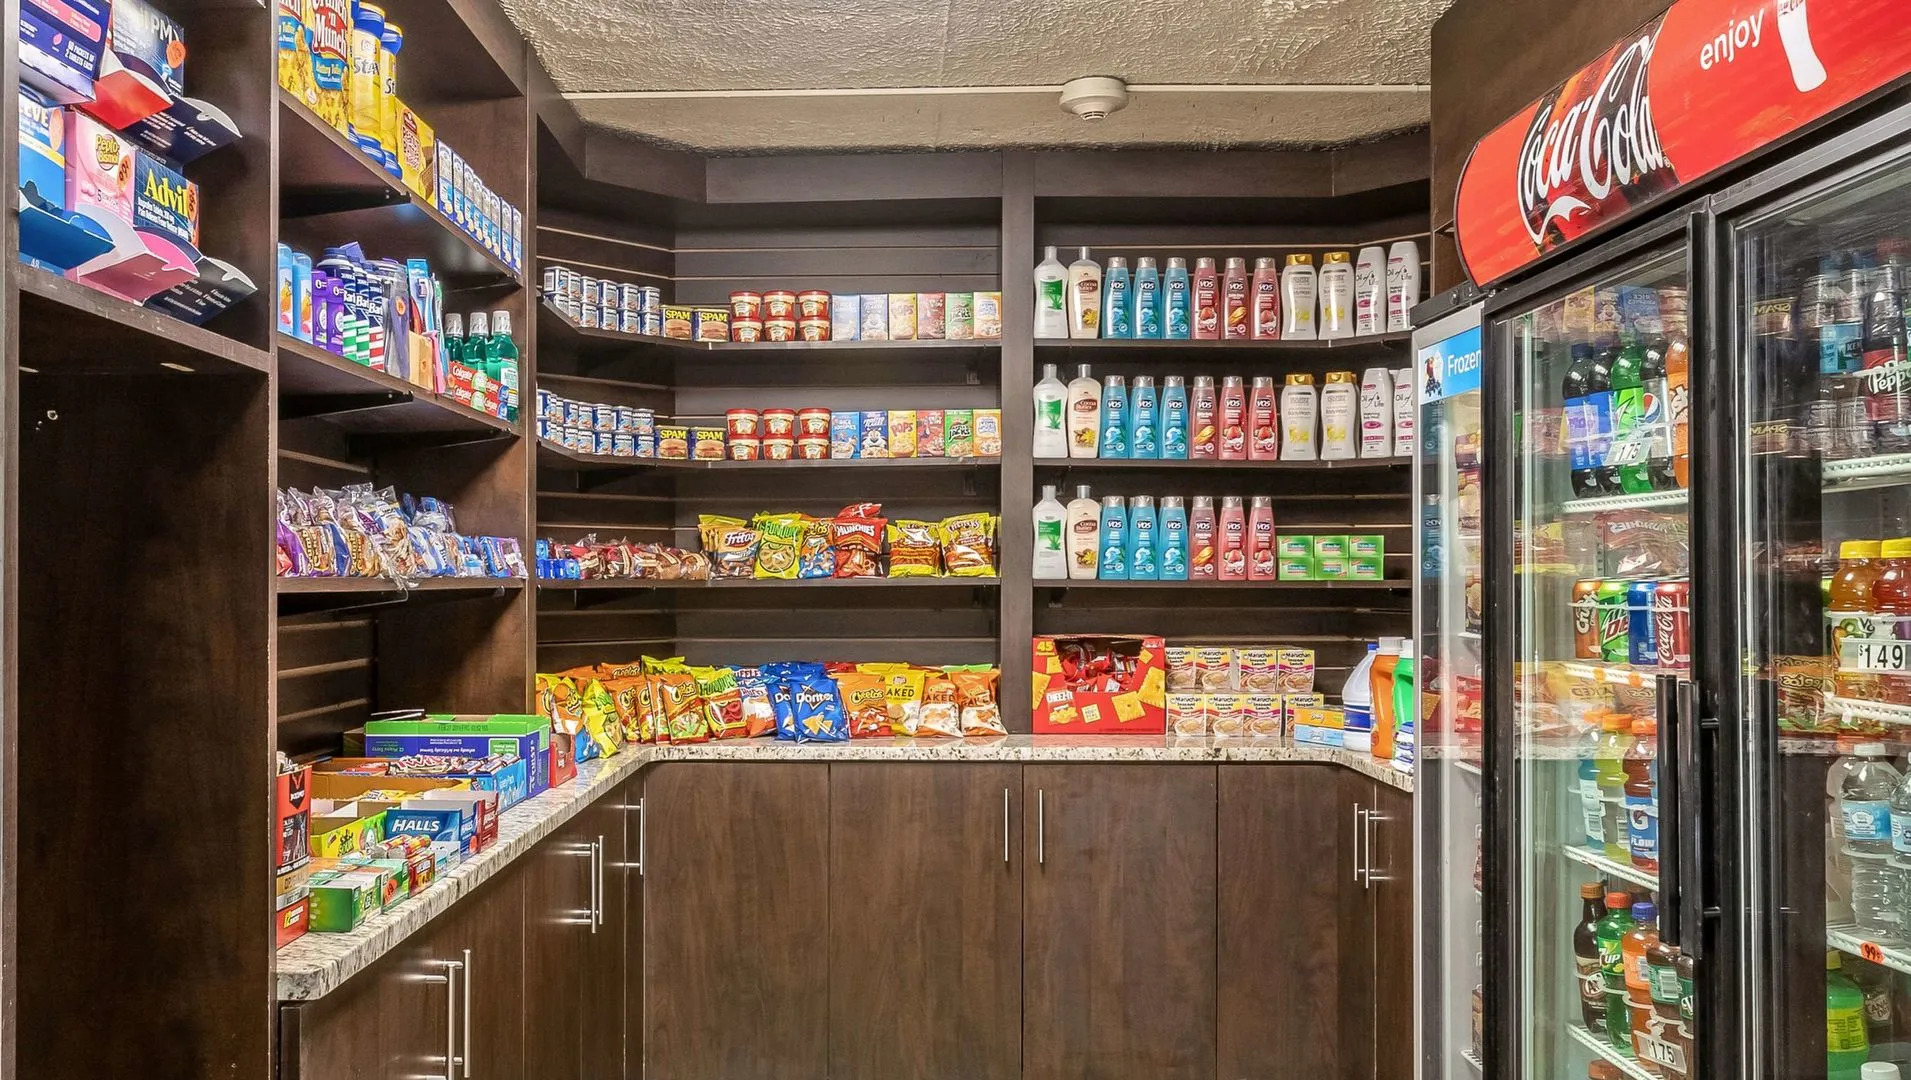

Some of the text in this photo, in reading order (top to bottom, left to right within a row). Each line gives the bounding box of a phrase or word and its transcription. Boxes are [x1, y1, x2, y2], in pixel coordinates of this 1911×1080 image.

[150, 15, 173, 41] PM
[313, 14, 346, 57] Munch
[1700, 8, 1764, 71] enjoy
[1517, 34, 1668, 246] Coca-Cola
[144, 167, 189, 217] Advil
[665, 309, 690, 320] SPAM
[701, 311, 728, 322] SPAM
[1447, 349, 1481, 377] Frozen
[453, 365, 473, 380] Colgate
[660, 430, 686, 439] SPAM
[696, 431, 723, 440] SPAM
[891, 422, 913, 436] POPS
[836, 523, 875, 536] MUNCHIES
[725, 531, 754, 545] Fritos
[1037, 641, 1054, 652] 45
[1860, 644, 1903, 669] $1.49
[796, 692, 834, 704] Doritos
[851, 688, 884, 706] Cheetos
[886, 688, 914, 698] AKED
[392, 819, 440, 832] HALLS
